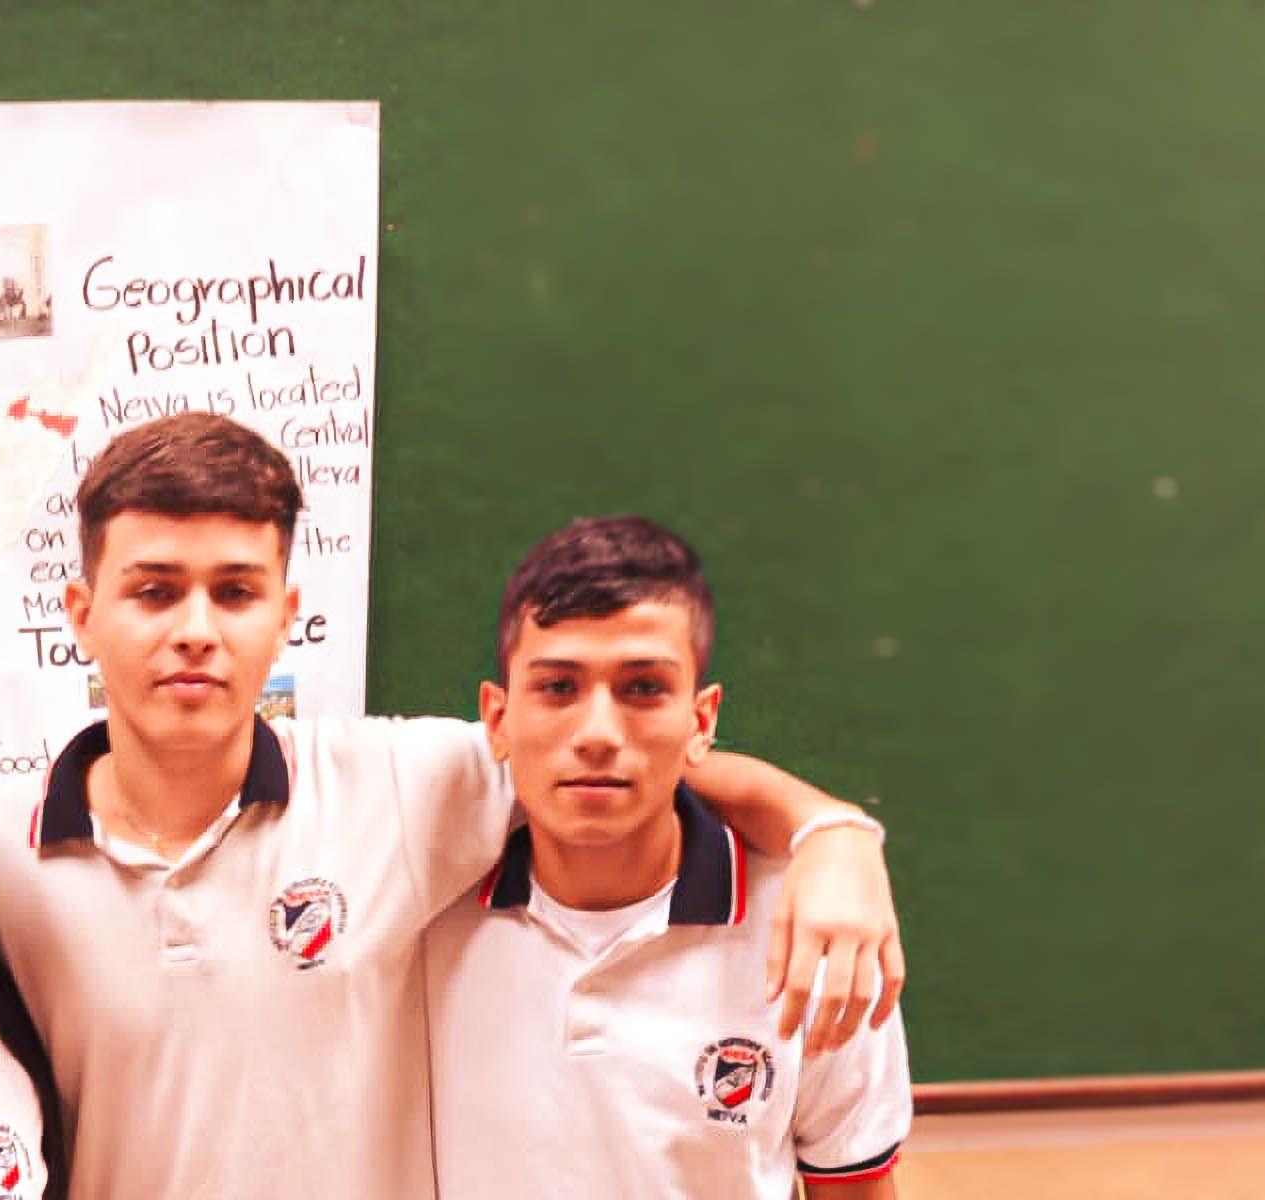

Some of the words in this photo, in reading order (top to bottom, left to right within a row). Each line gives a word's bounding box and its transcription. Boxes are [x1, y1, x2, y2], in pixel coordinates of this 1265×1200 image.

[82, 255, 366, 325] Geographical
[126, 317, 295, 375] Position
[98, 384, 189, 428] Neiva
[247, 364, 361, 411] located
[26, 528, 64, 552] on
[31, 560, 81, 583] eas
